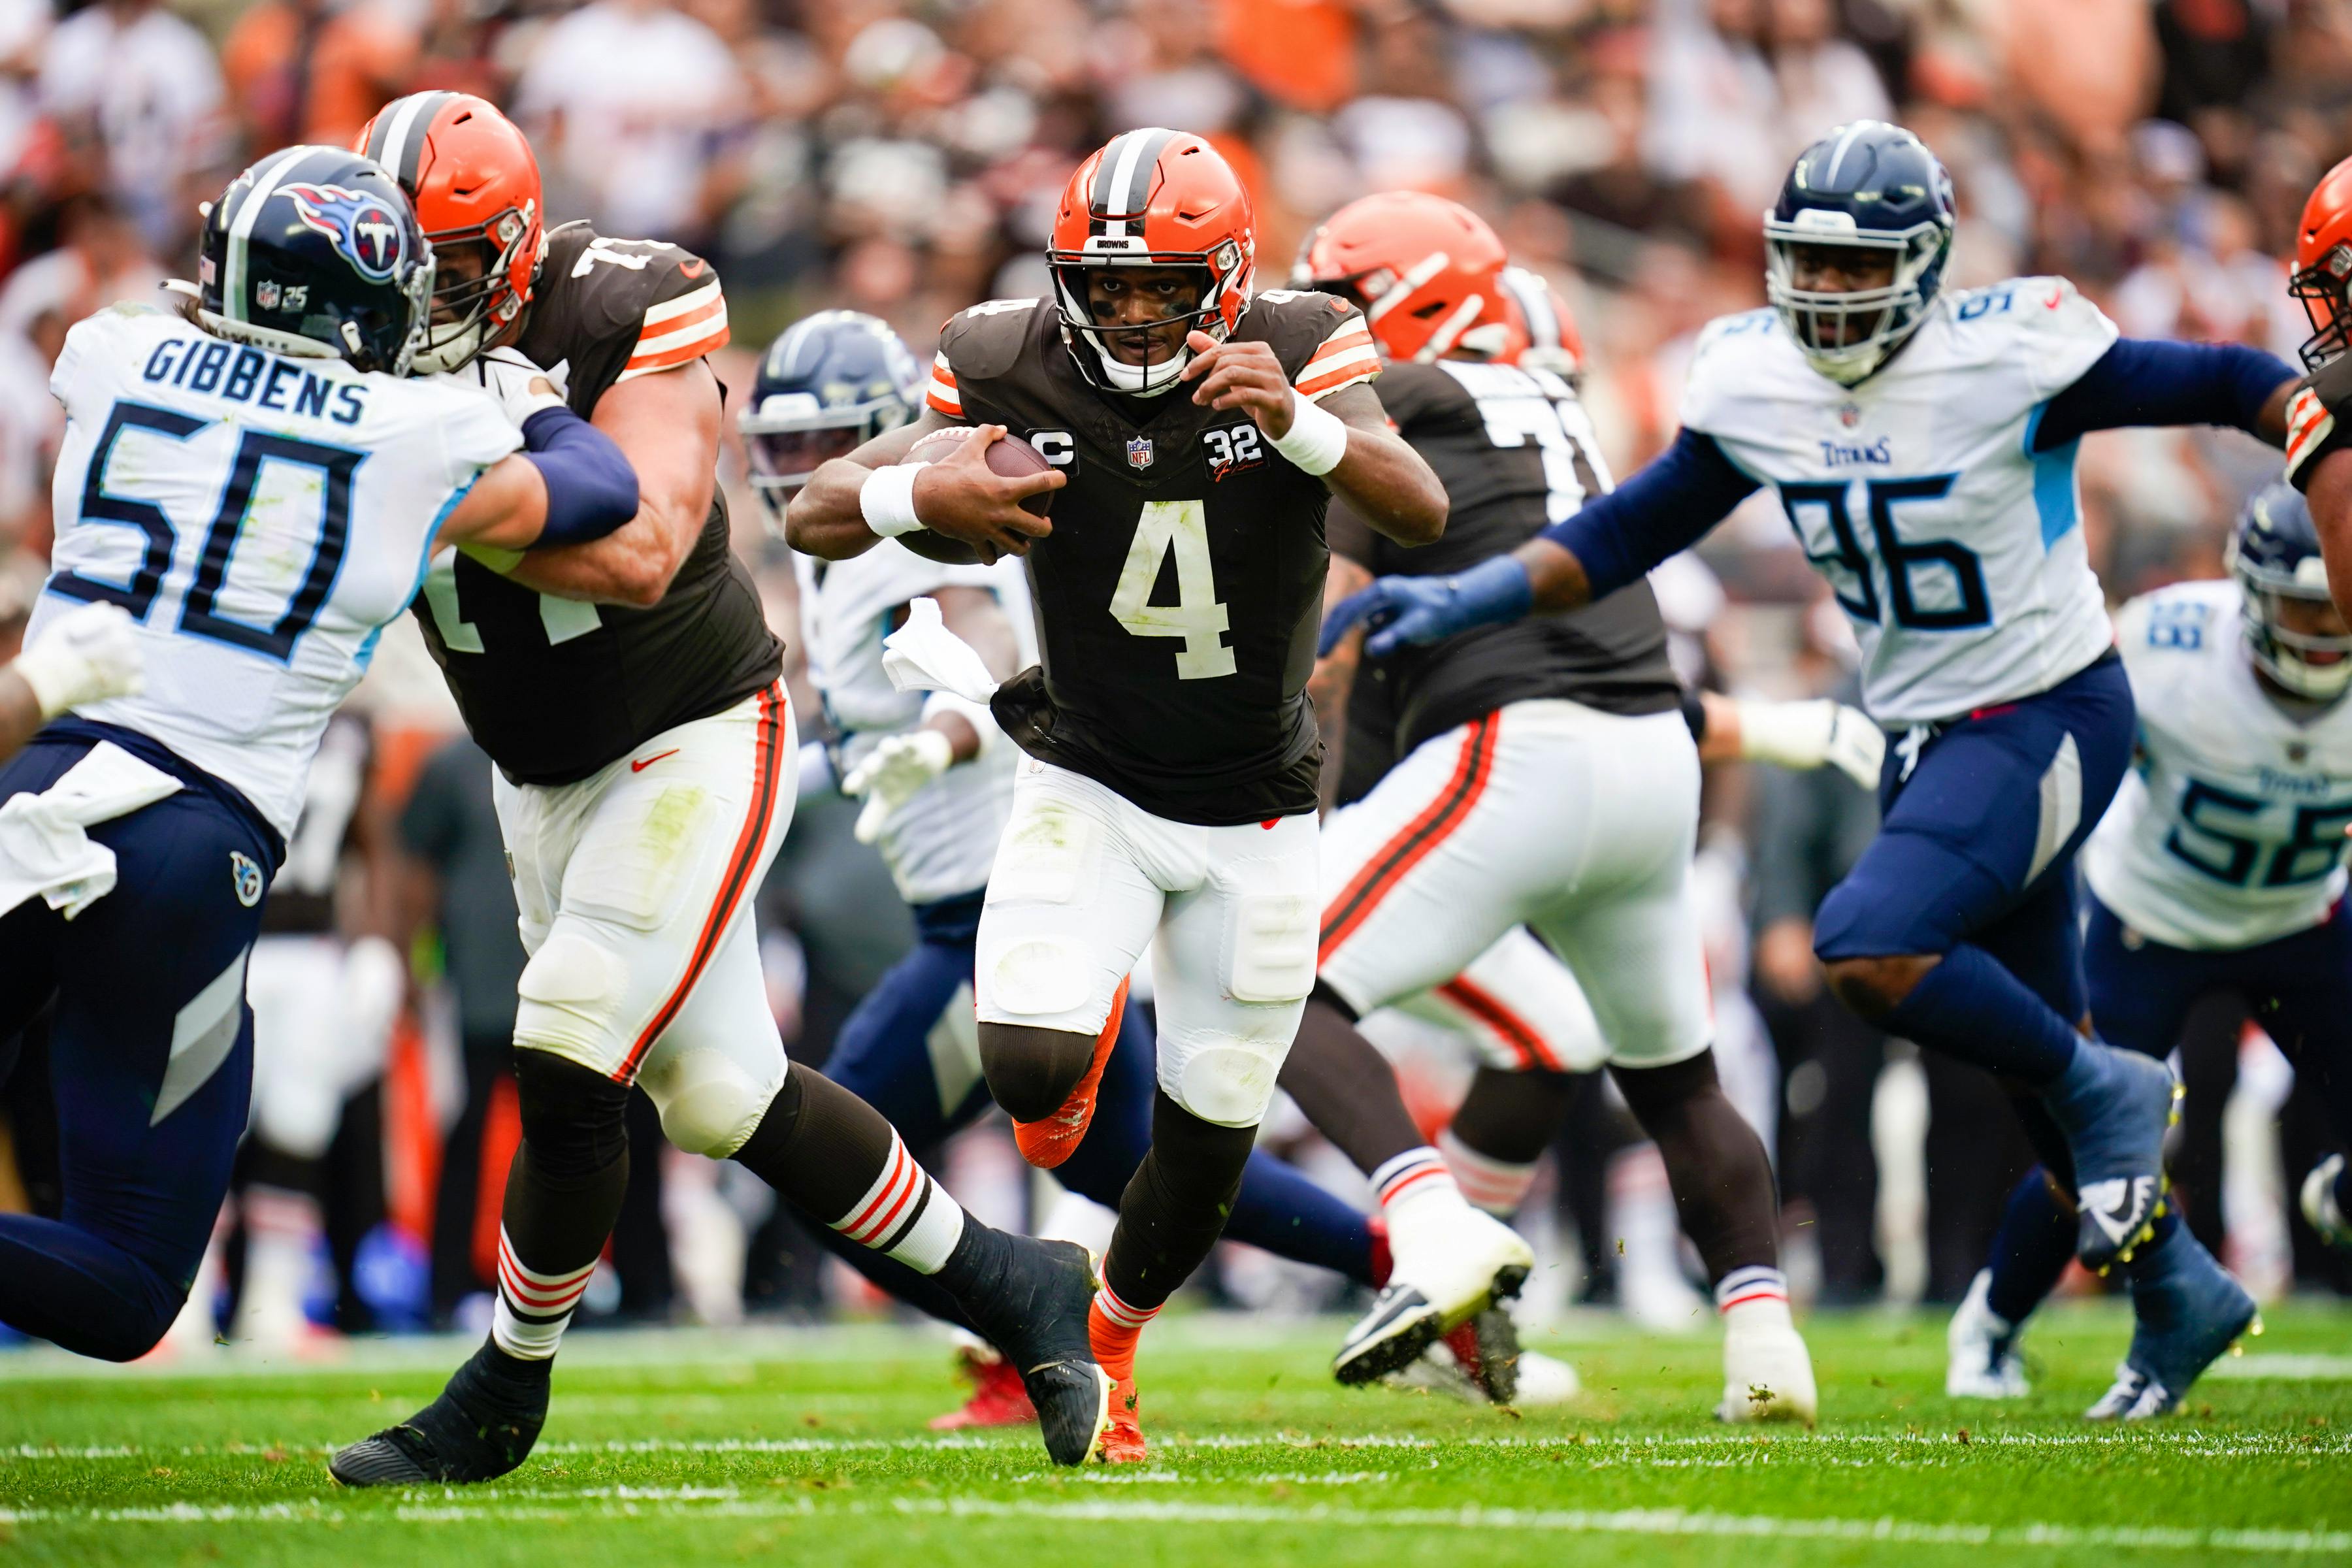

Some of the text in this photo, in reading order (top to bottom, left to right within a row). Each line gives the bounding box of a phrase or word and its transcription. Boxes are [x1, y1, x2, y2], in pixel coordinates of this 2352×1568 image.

[1097, 240, 1129, 249] BROWNS
[967, 298, 1040, 319] 4
[144, 339, 369, 425] GIBBENS
[1030, 431, 1073, 465] C
[1131, 451, 1150, 465] NFL
[1203, 424, 1262, 468] 32
[46, 400, 370, 667] 50
[1776, 471, 1993, 629] 96
[1109, 499, 1238, 680] 4
[2164, 777, 2352, 887] 58
